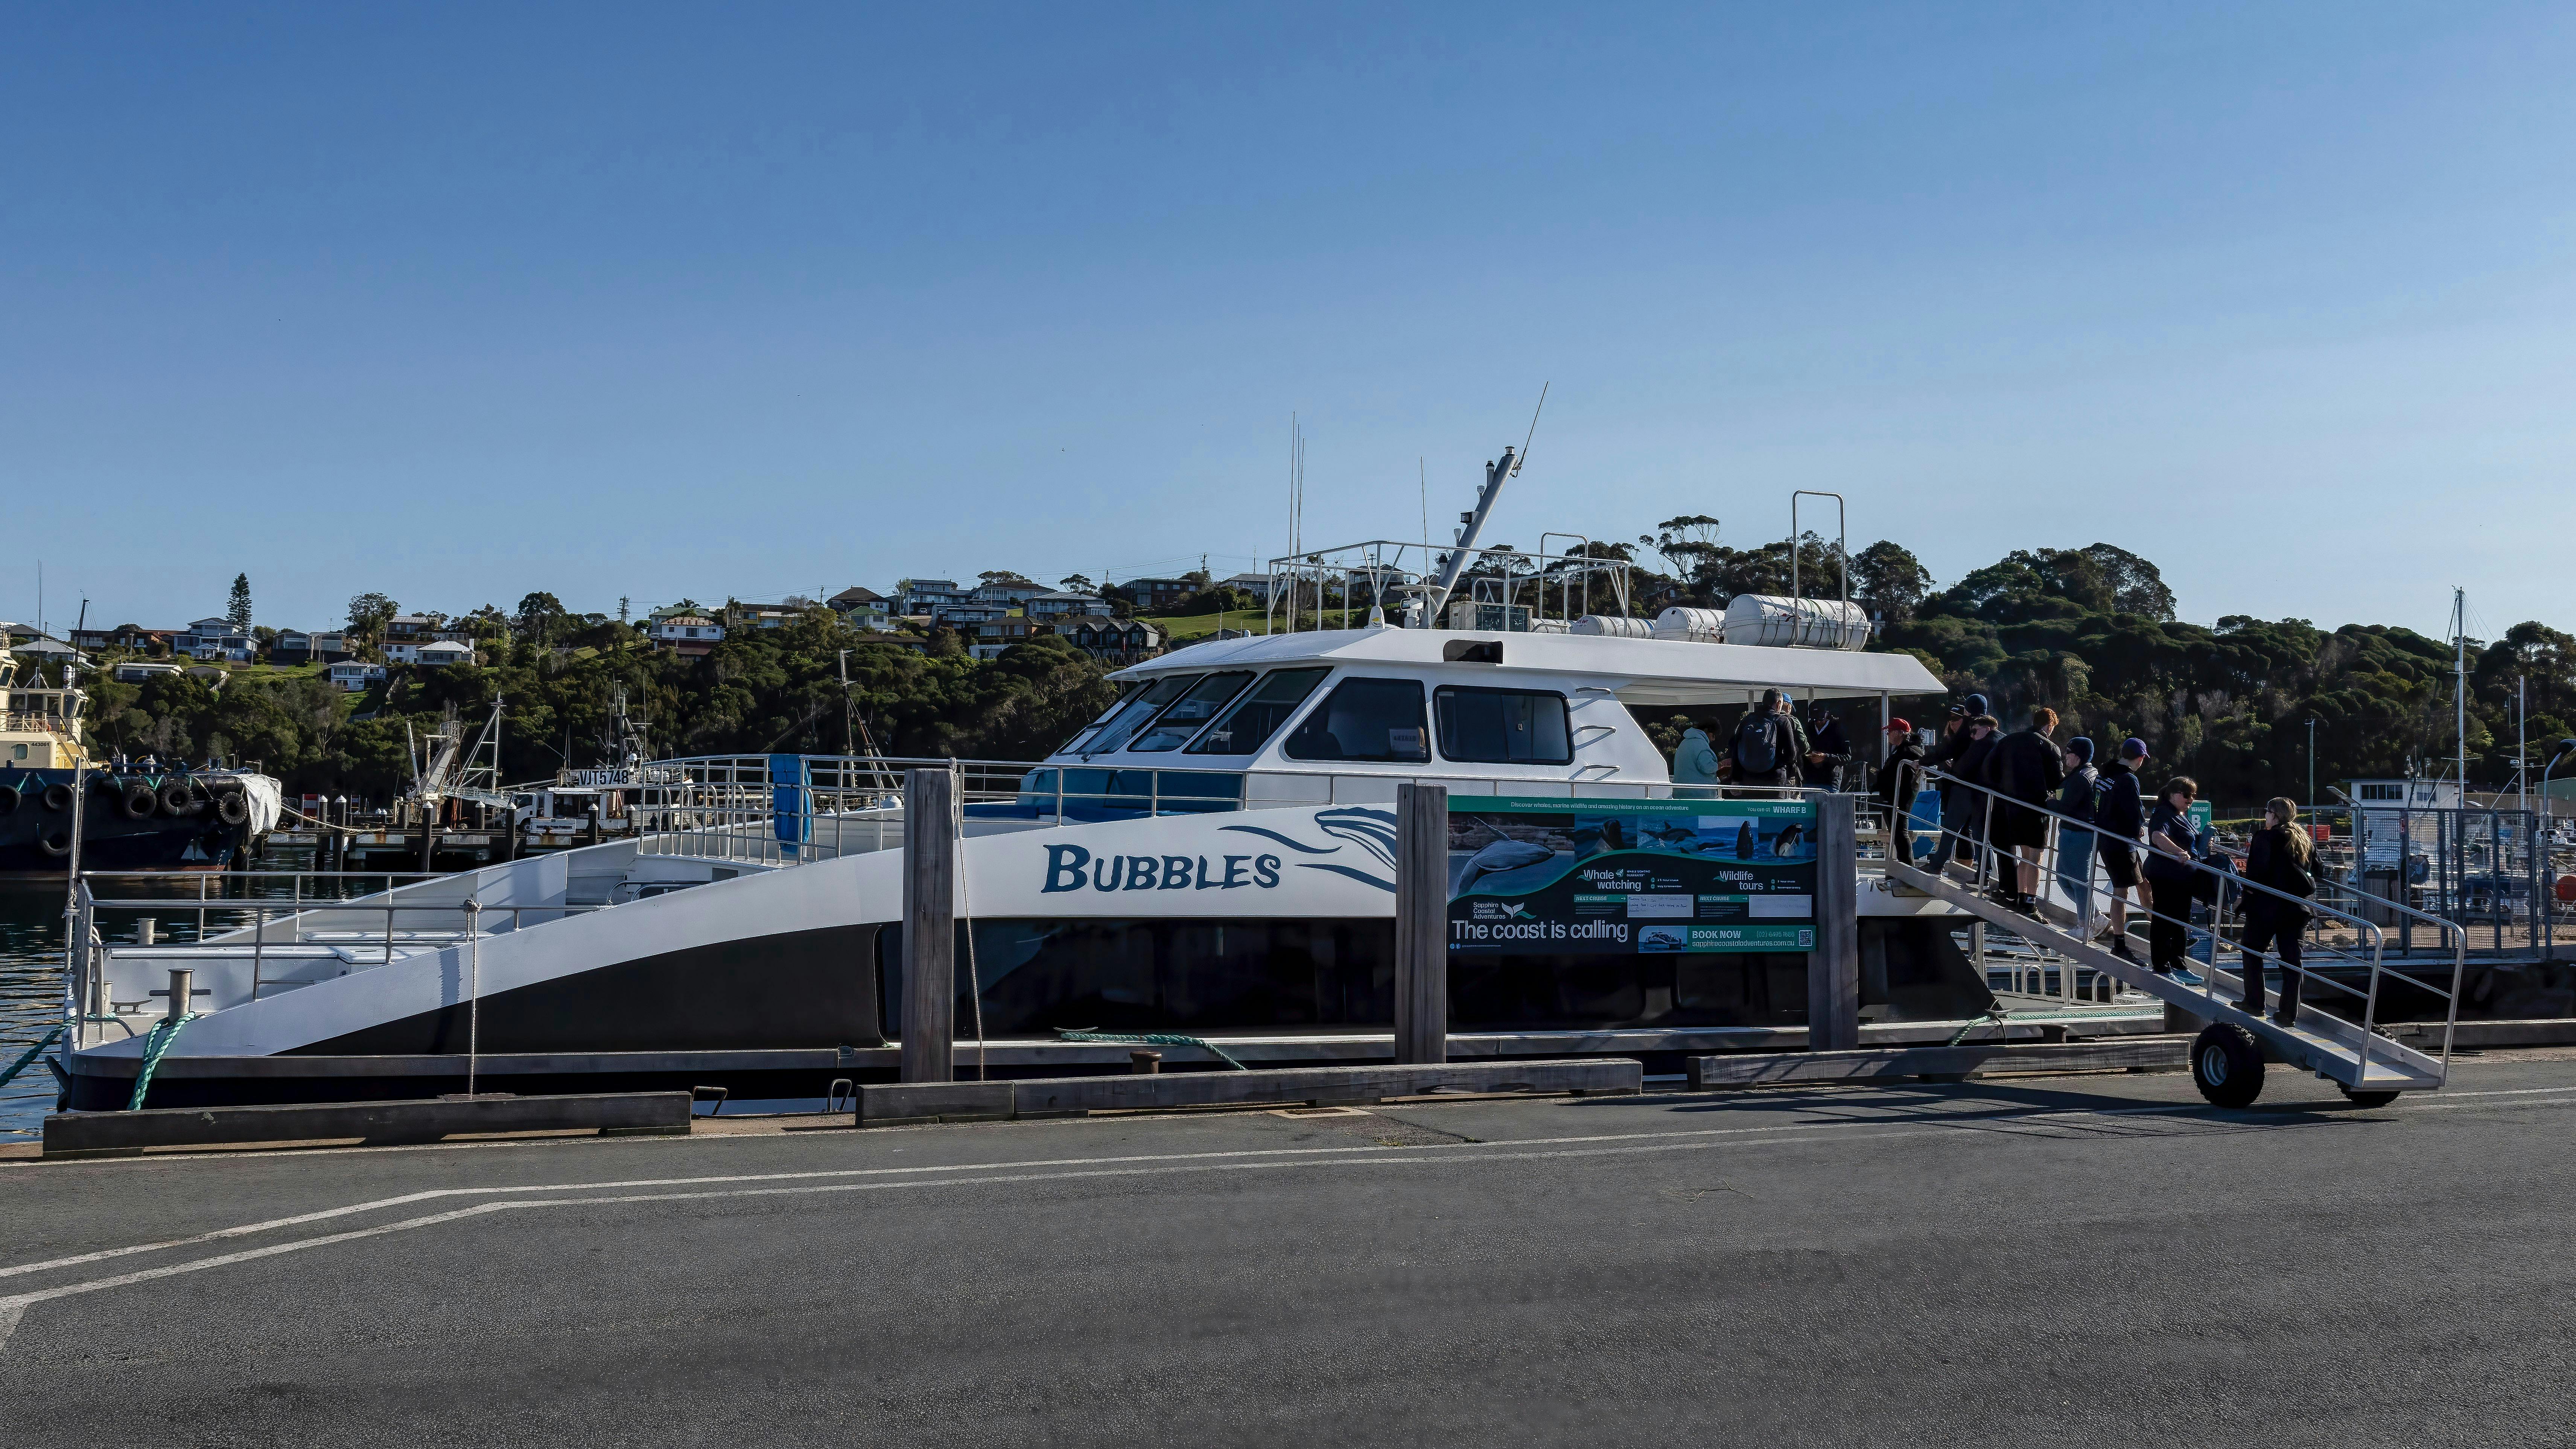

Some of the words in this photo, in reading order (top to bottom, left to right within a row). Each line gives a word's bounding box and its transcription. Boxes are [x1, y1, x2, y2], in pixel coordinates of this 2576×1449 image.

[580, 770, 629, 785] VJT5748
[2191, 814, 2201, 828] B
[1041, 843, 1281, 893] BUBBLES
[1584, 870, 1614, 879] Whale
[1720, 871, 1753, 880] Wildlife
[1597, 880, 1641, 891] watching
[1739, 881, 1763, 890] tours
[1452, 920, 1488, 939] The
[1493, 921, 1546, 939] coast
[1551, 920, 1566, 938] is
[1570, 920, 1628, 942] calling
